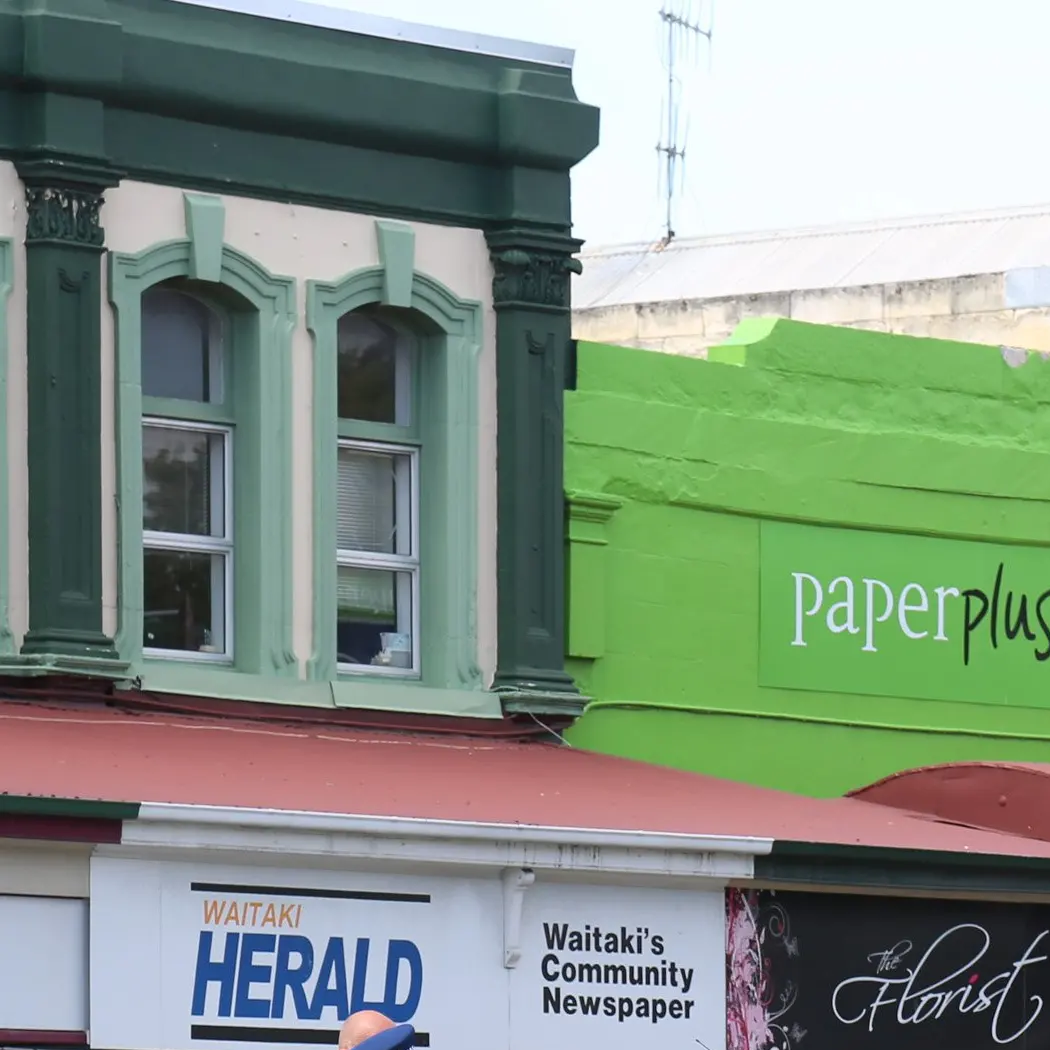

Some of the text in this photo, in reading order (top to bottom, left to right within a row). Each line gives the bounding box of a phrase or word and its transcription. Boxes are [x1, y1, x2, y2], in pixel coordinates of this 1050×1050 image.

[203, 900, 302, 928] WAITAKI
[543, 922, 664, 956] Waitaki's
[867, 939, 913, 975] The
[191, 930, 423, 1023] HERALD
[541, 953, 694, 993] Community
[832, 923, 1049, 1044] Florist
[542, 986, 695, 1024] Newspaper
